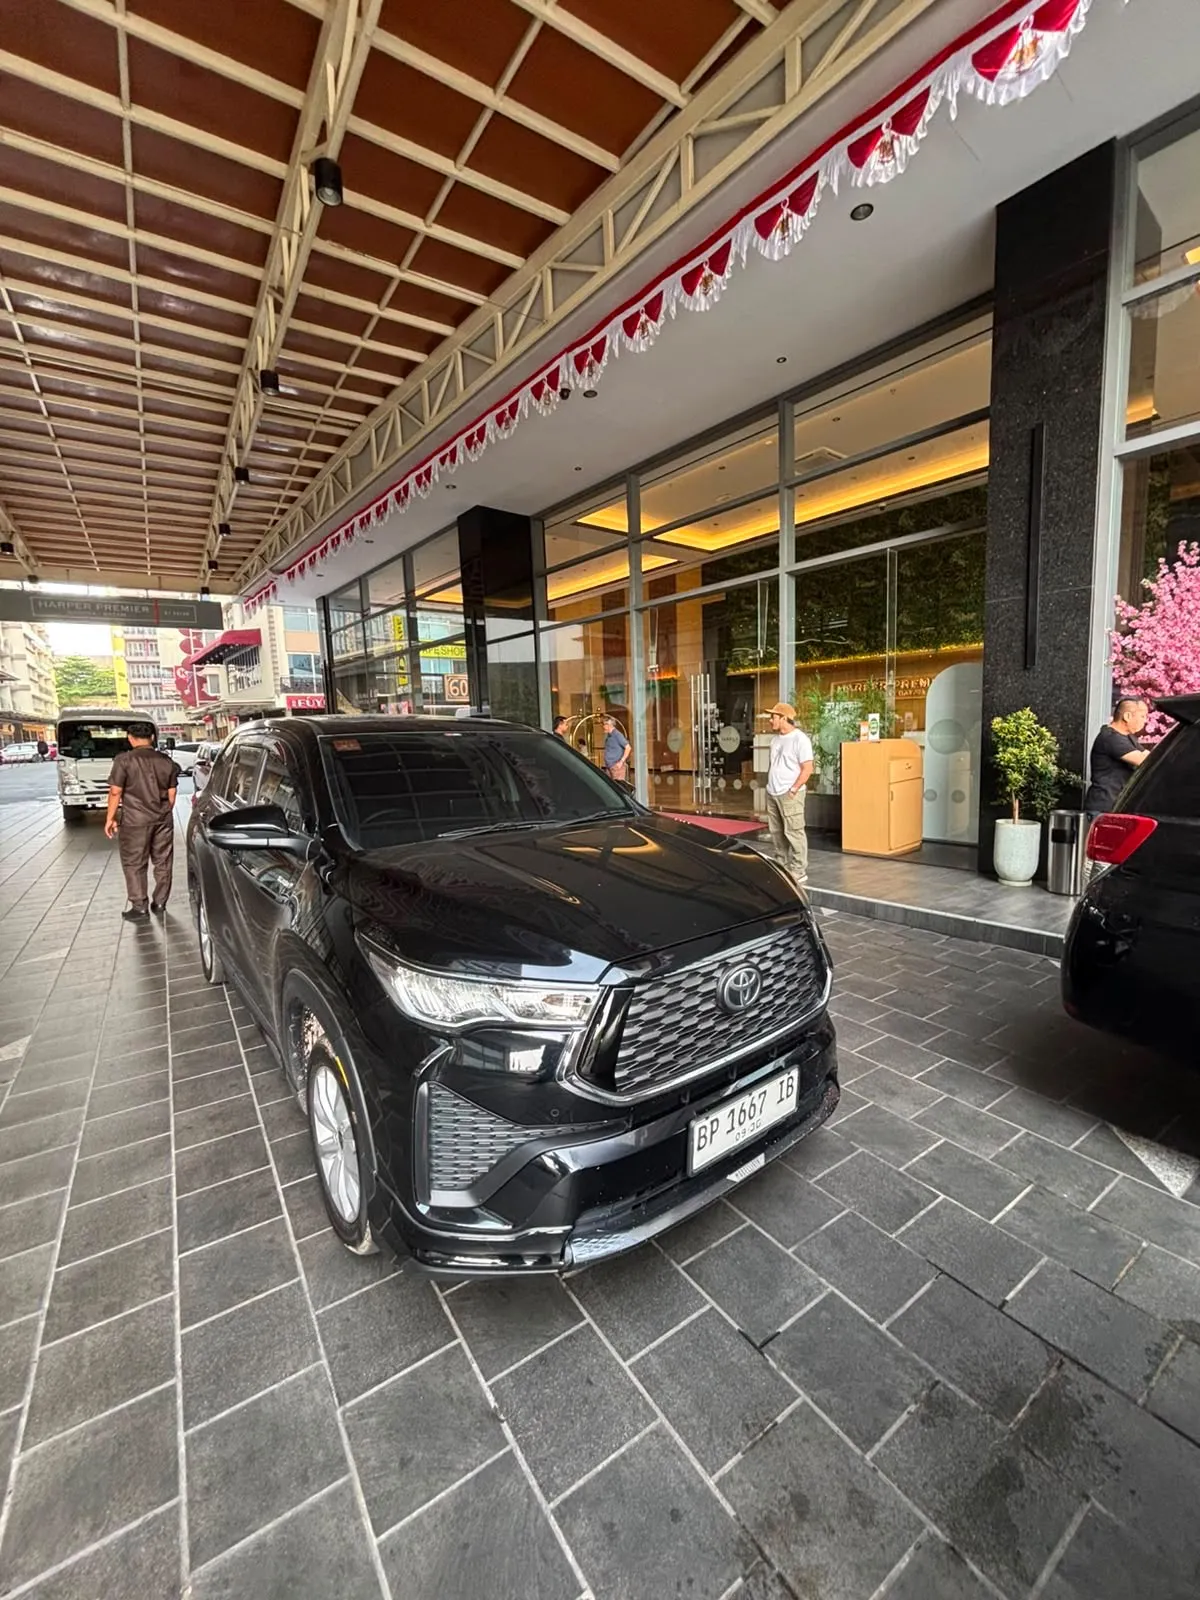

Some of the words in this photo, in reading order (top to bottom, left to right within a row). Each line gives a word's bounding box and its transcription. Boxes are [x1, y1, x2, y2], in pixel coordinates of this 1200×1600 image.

[37, 600, 93, 611] HARPER
[96, 602, 150, 613] PREMIER
[696, 1117, 720, 1151] BP
[726, 1089, 767, 1134] 1667
[776, 1075, 794, 1104] IB
